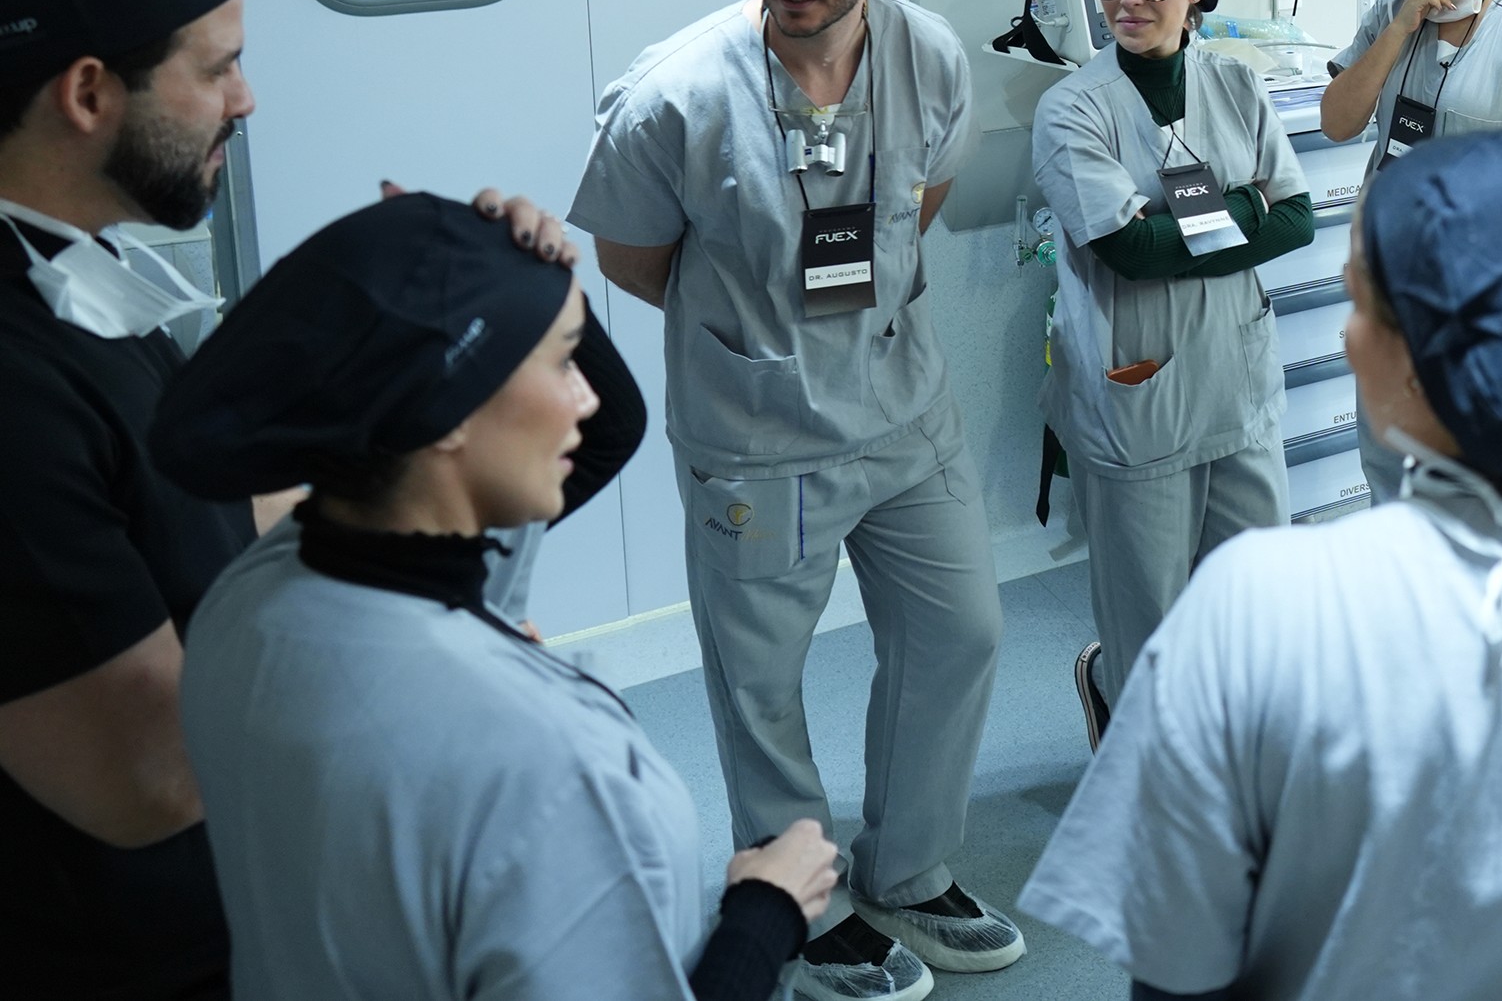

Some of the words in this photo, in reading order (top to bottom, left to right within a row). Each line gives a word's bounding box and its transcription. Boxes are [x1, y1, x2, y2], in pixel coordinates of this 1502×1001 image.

[1399, 116, 1424, 133] FUEX
[1174, 185, 1209, 199] FUEX
[815, 230, 858, 244] FUEX
[826, 268, 868, 280] AUGUSTO
